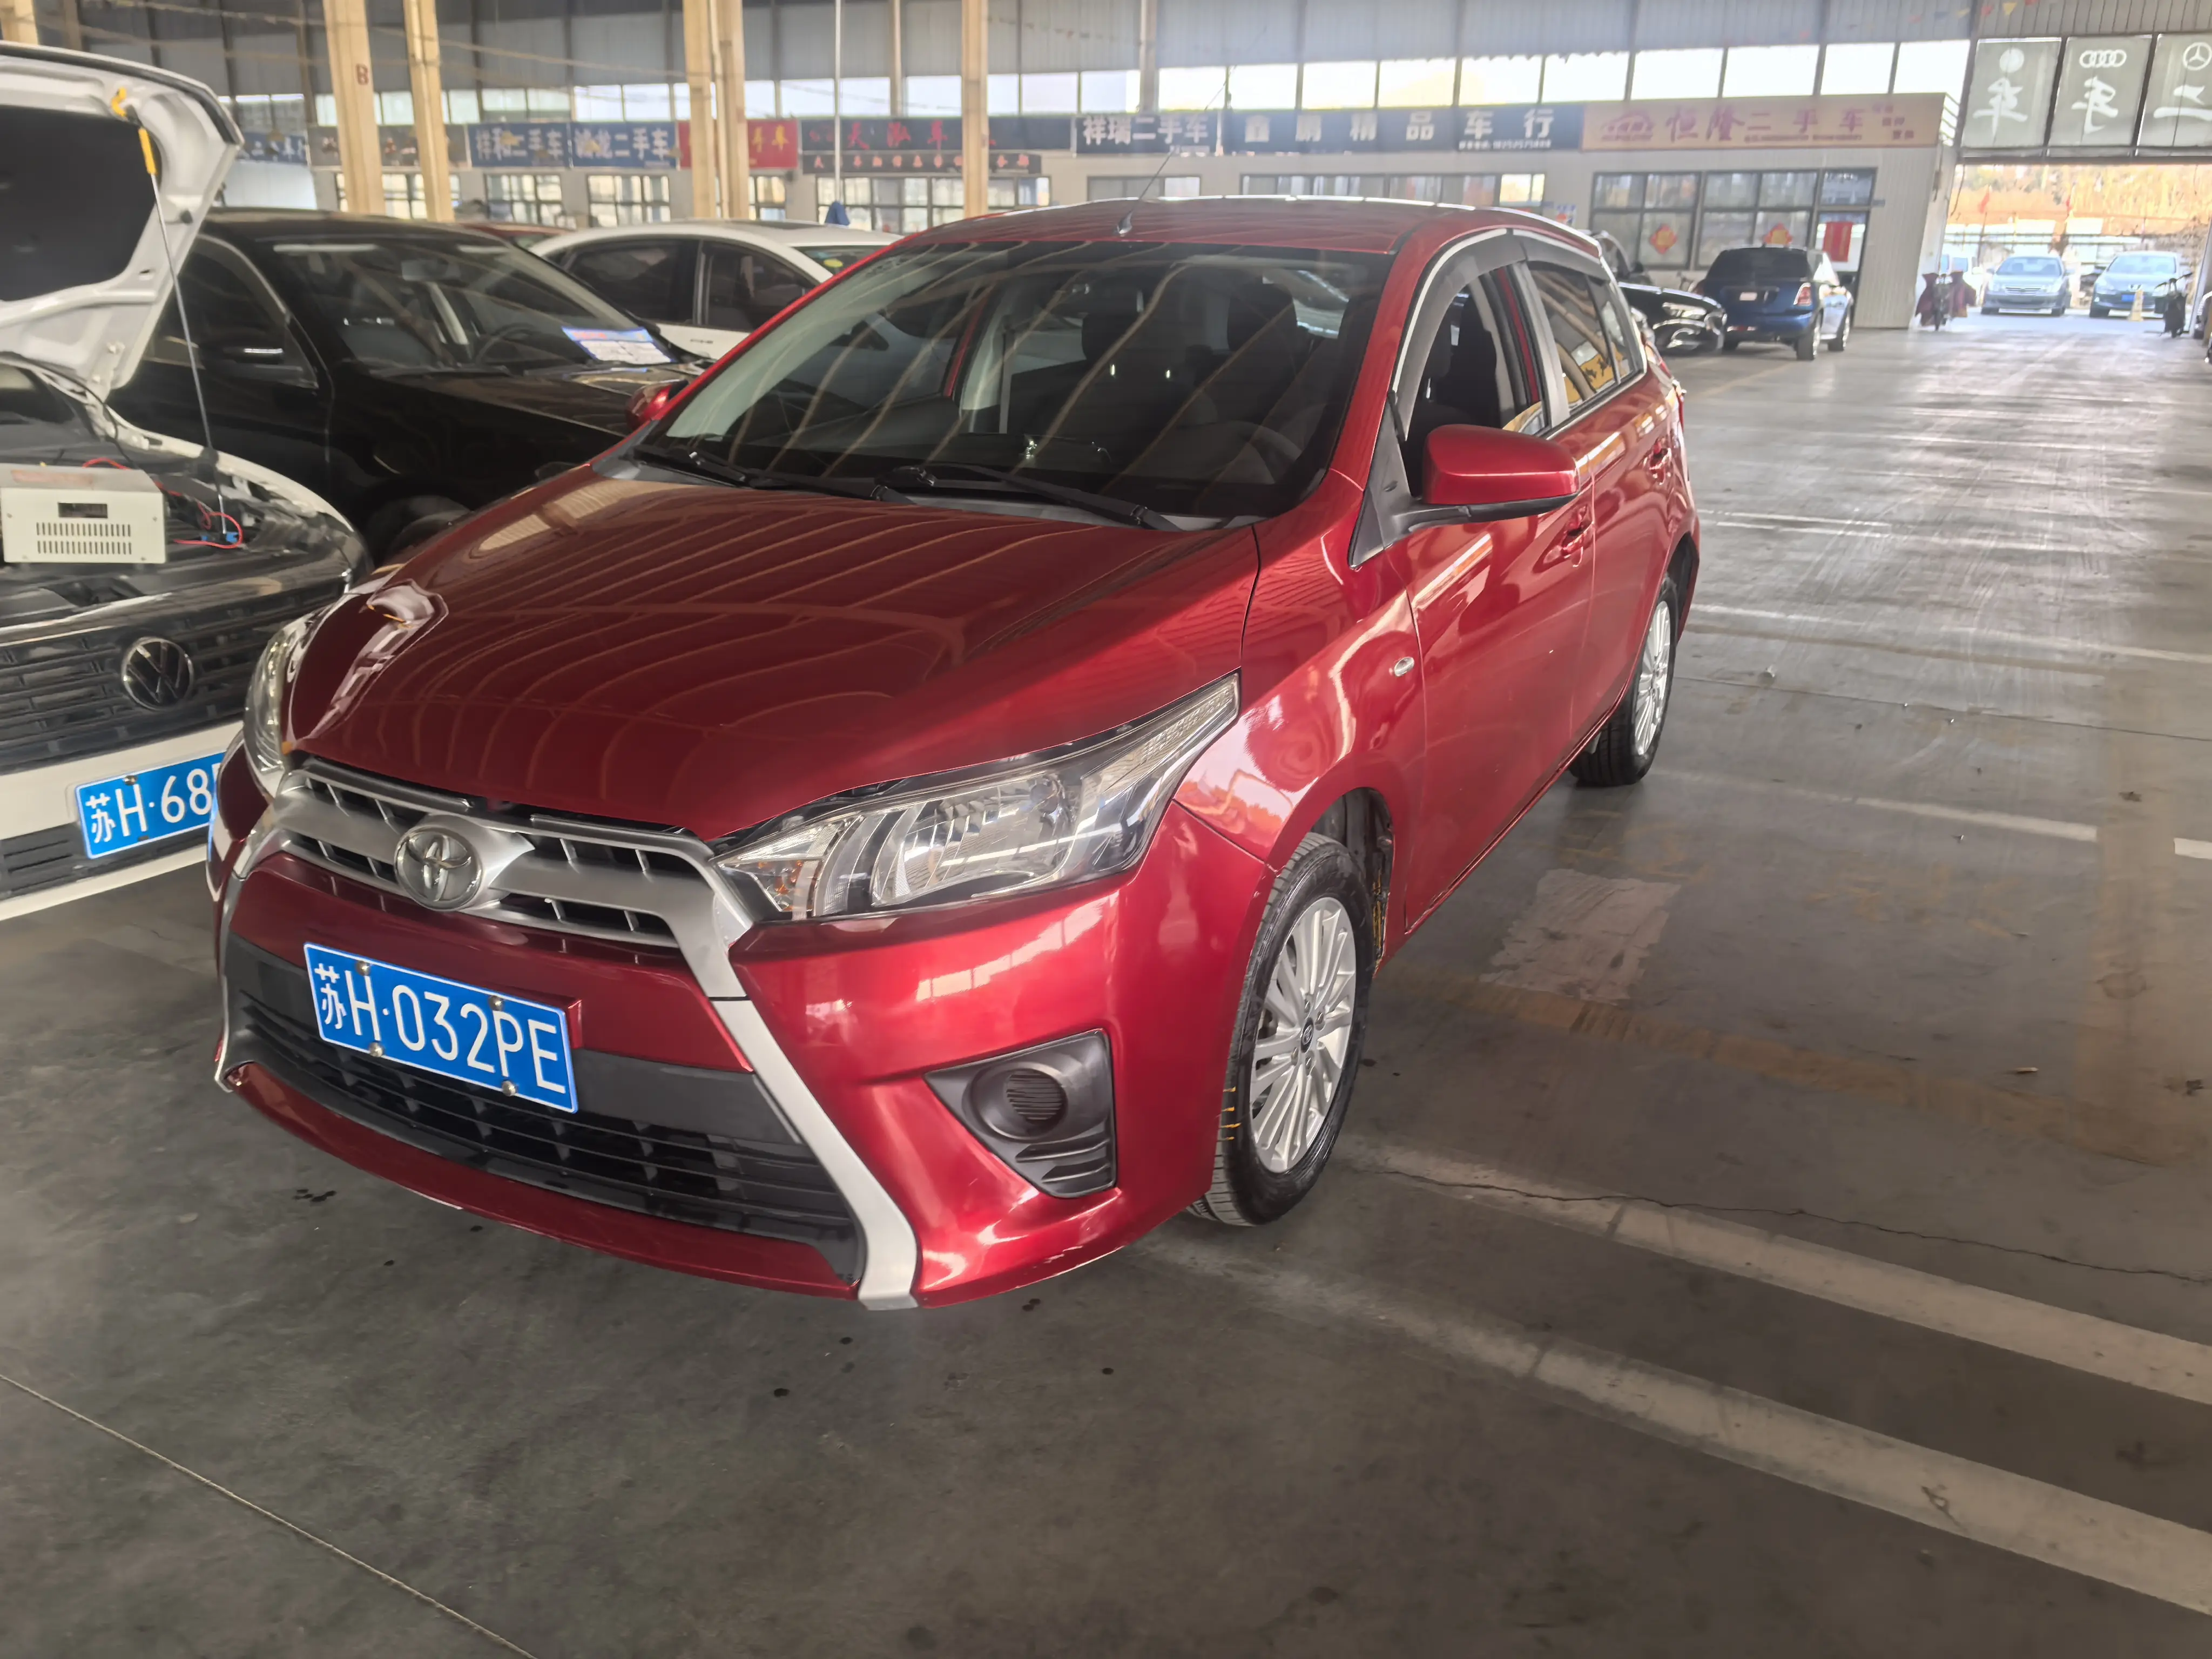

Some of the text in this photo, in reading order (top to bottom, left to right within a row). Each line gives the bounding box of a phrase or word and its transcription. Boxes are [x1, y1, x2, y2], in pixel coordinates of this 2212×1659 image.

[355, 63, 369, 86] B
[84, 763, 222, 844] 苏H·68
[313, 961, 567, 1095] 苏H·032PE
